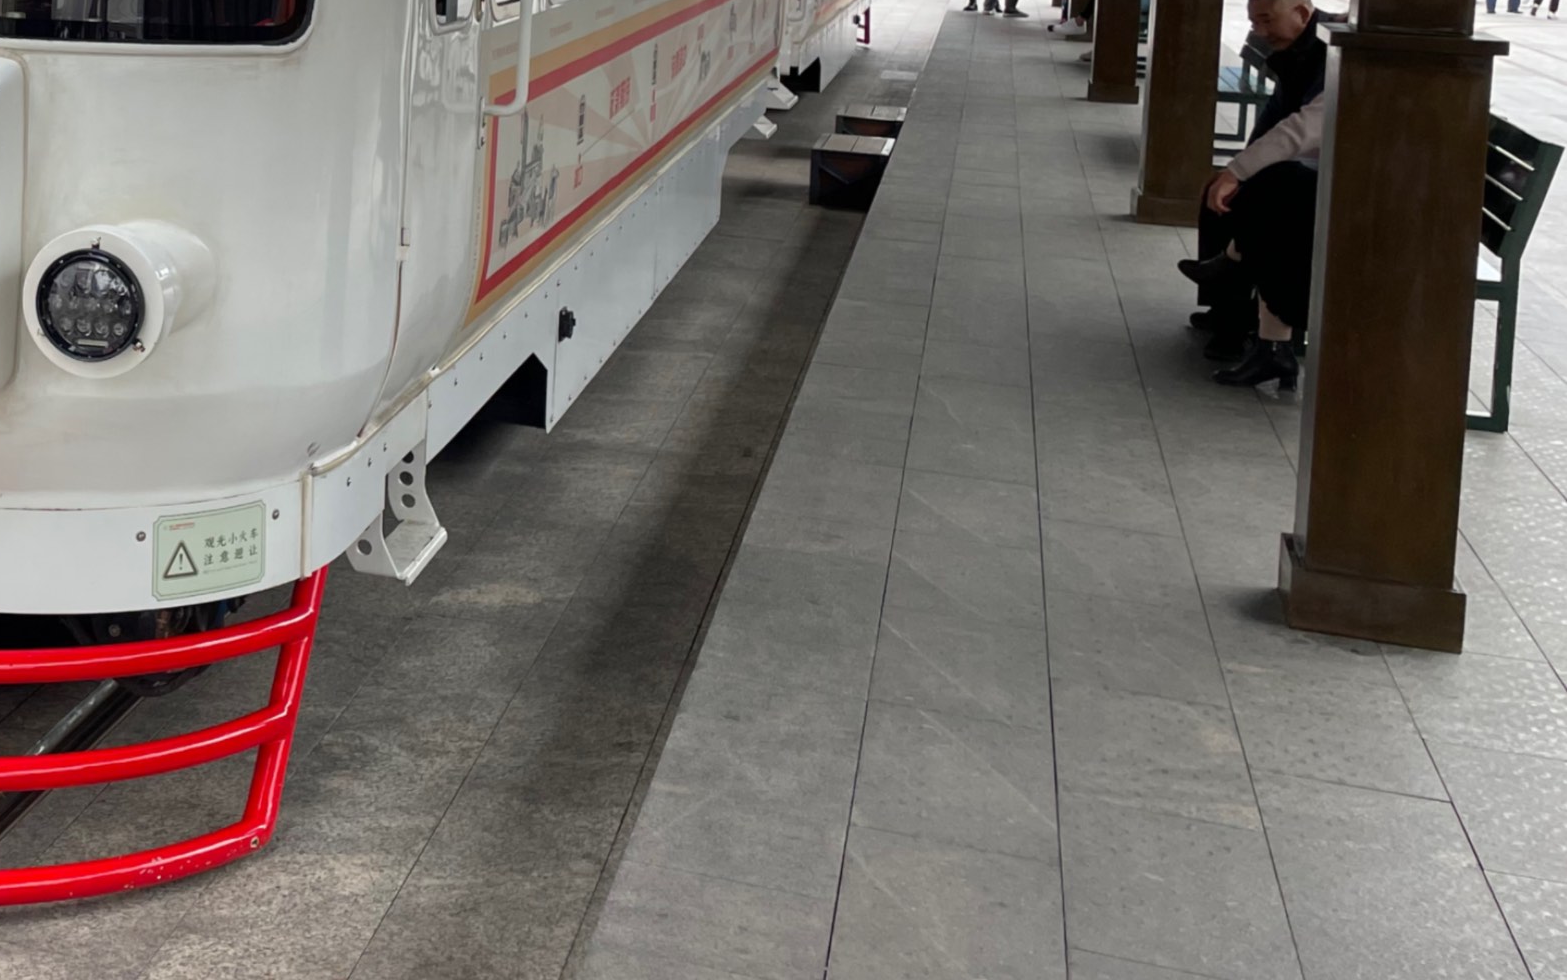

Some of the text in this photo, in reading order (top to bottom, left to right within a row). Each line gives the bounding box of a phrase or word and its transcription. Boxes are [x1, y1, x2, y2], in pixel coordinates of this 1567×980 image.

[204, 528, 258, 548] 观光小火车
[203, 544, 258, 566] 注意避让
